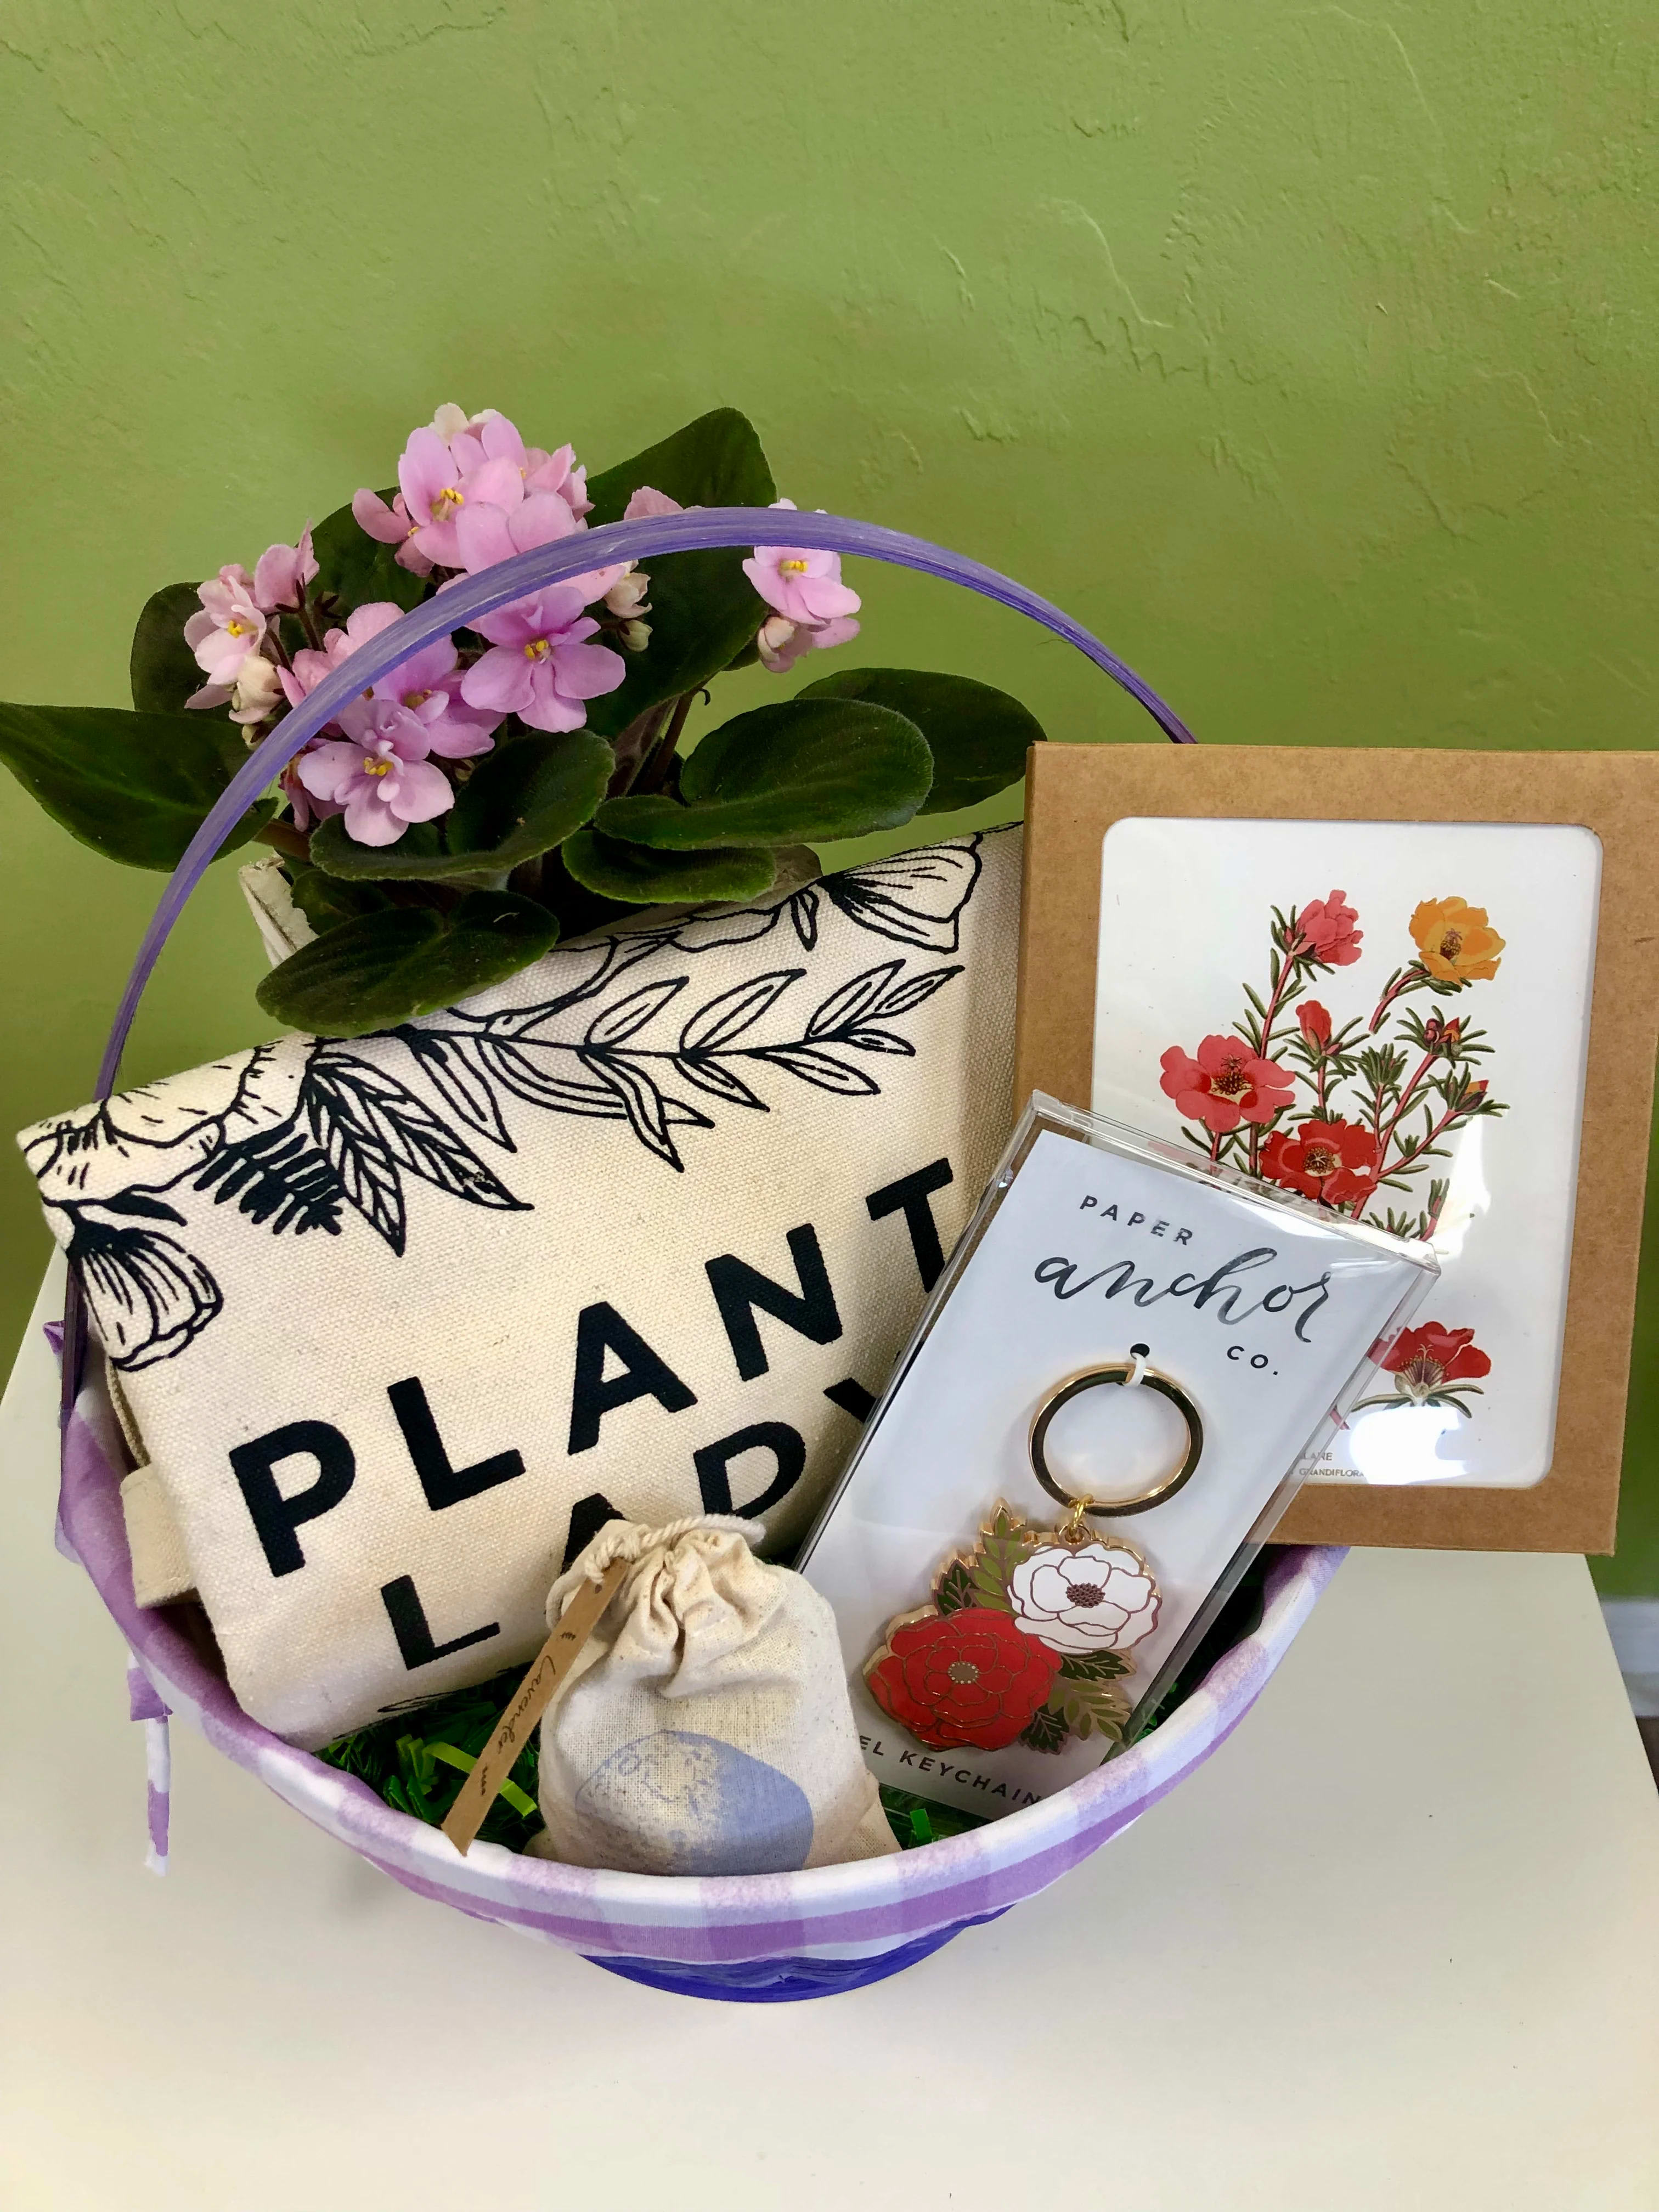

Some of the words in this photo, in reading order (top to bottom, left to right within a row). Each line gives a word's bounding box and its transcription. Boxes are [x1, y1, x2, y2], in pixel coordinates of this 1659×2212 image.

[1079, 1194, 1194, 1246] PAPER
[1034, 1247, 1331, 1343] anchor
[228, 1157, 954, 1578] PLANT
[1226, 1345, 1279, 1375] CO.
[497, 1655, 556, 1755] Lavender
[899, 1750, 1042, 1805] KEYCHAIN
